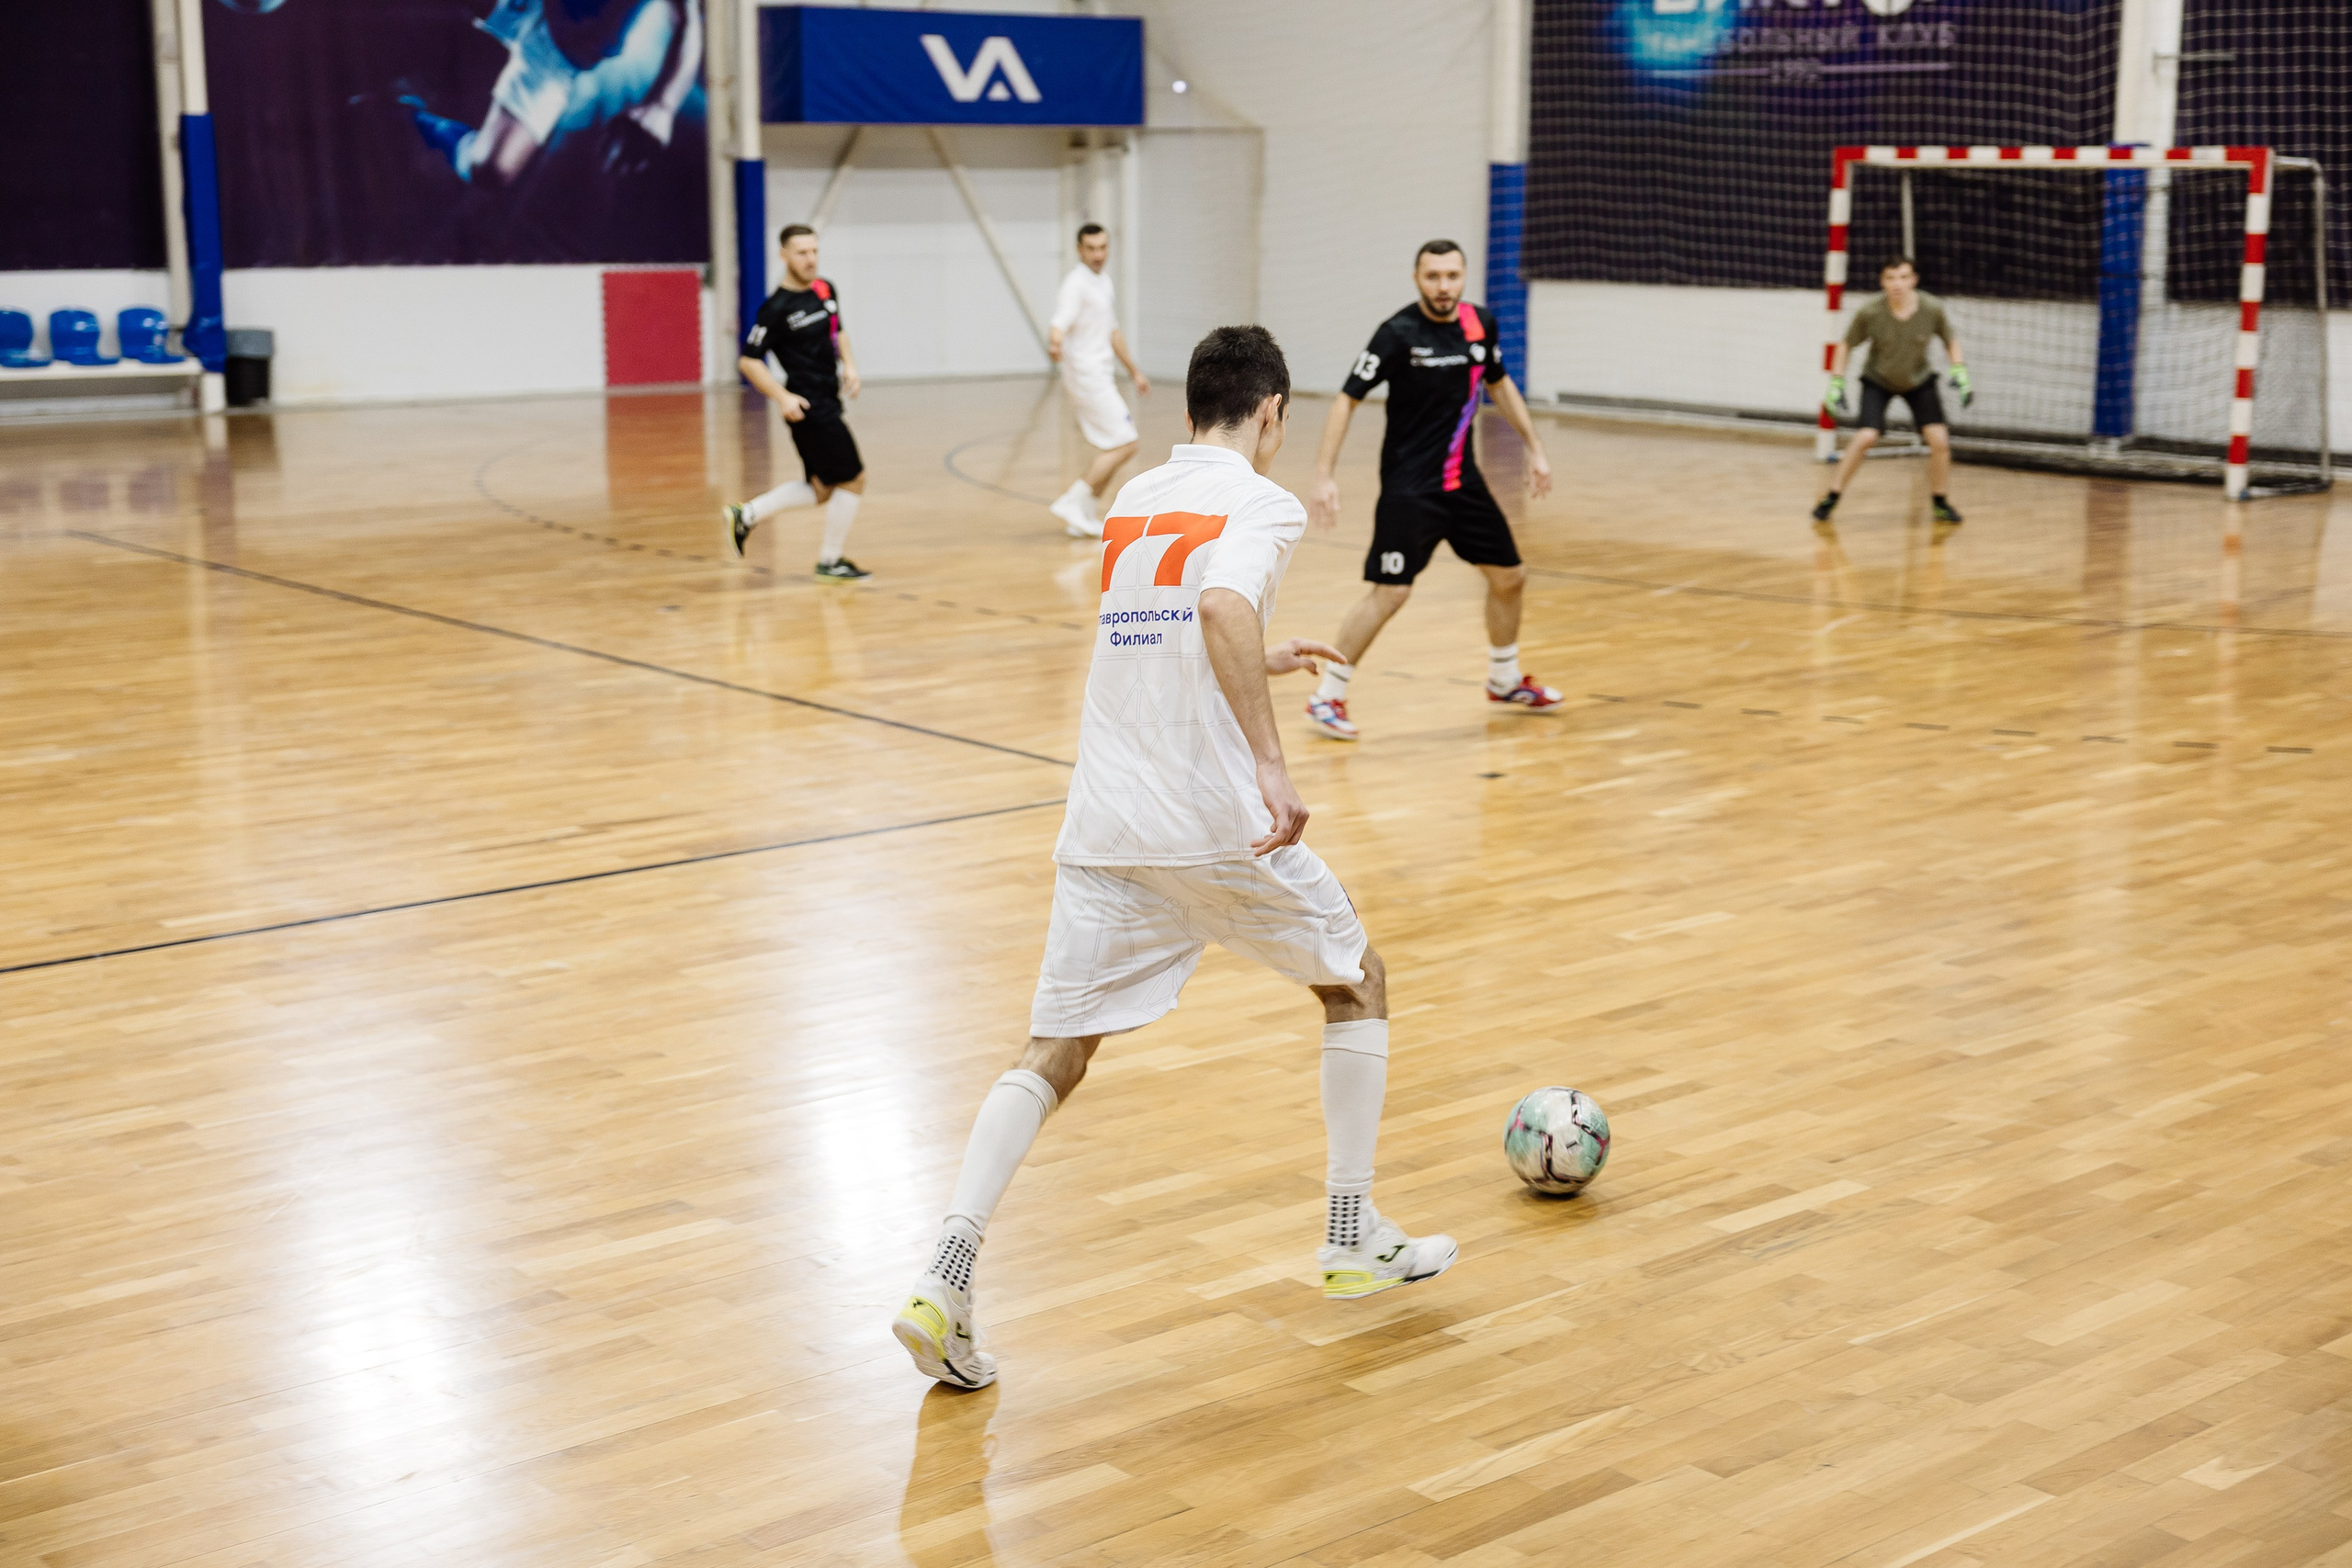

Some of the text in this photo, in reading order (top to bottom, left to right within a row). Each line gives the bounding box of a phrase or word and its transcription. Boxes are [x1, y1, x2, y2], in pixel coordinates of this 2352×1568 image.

[1353, 349, 1381, 381] 13
[1102, 511, 1228, 593] 77
[1380, 551, 1405, 575] 10
[1110, 631, 1162, 647] Филиал
